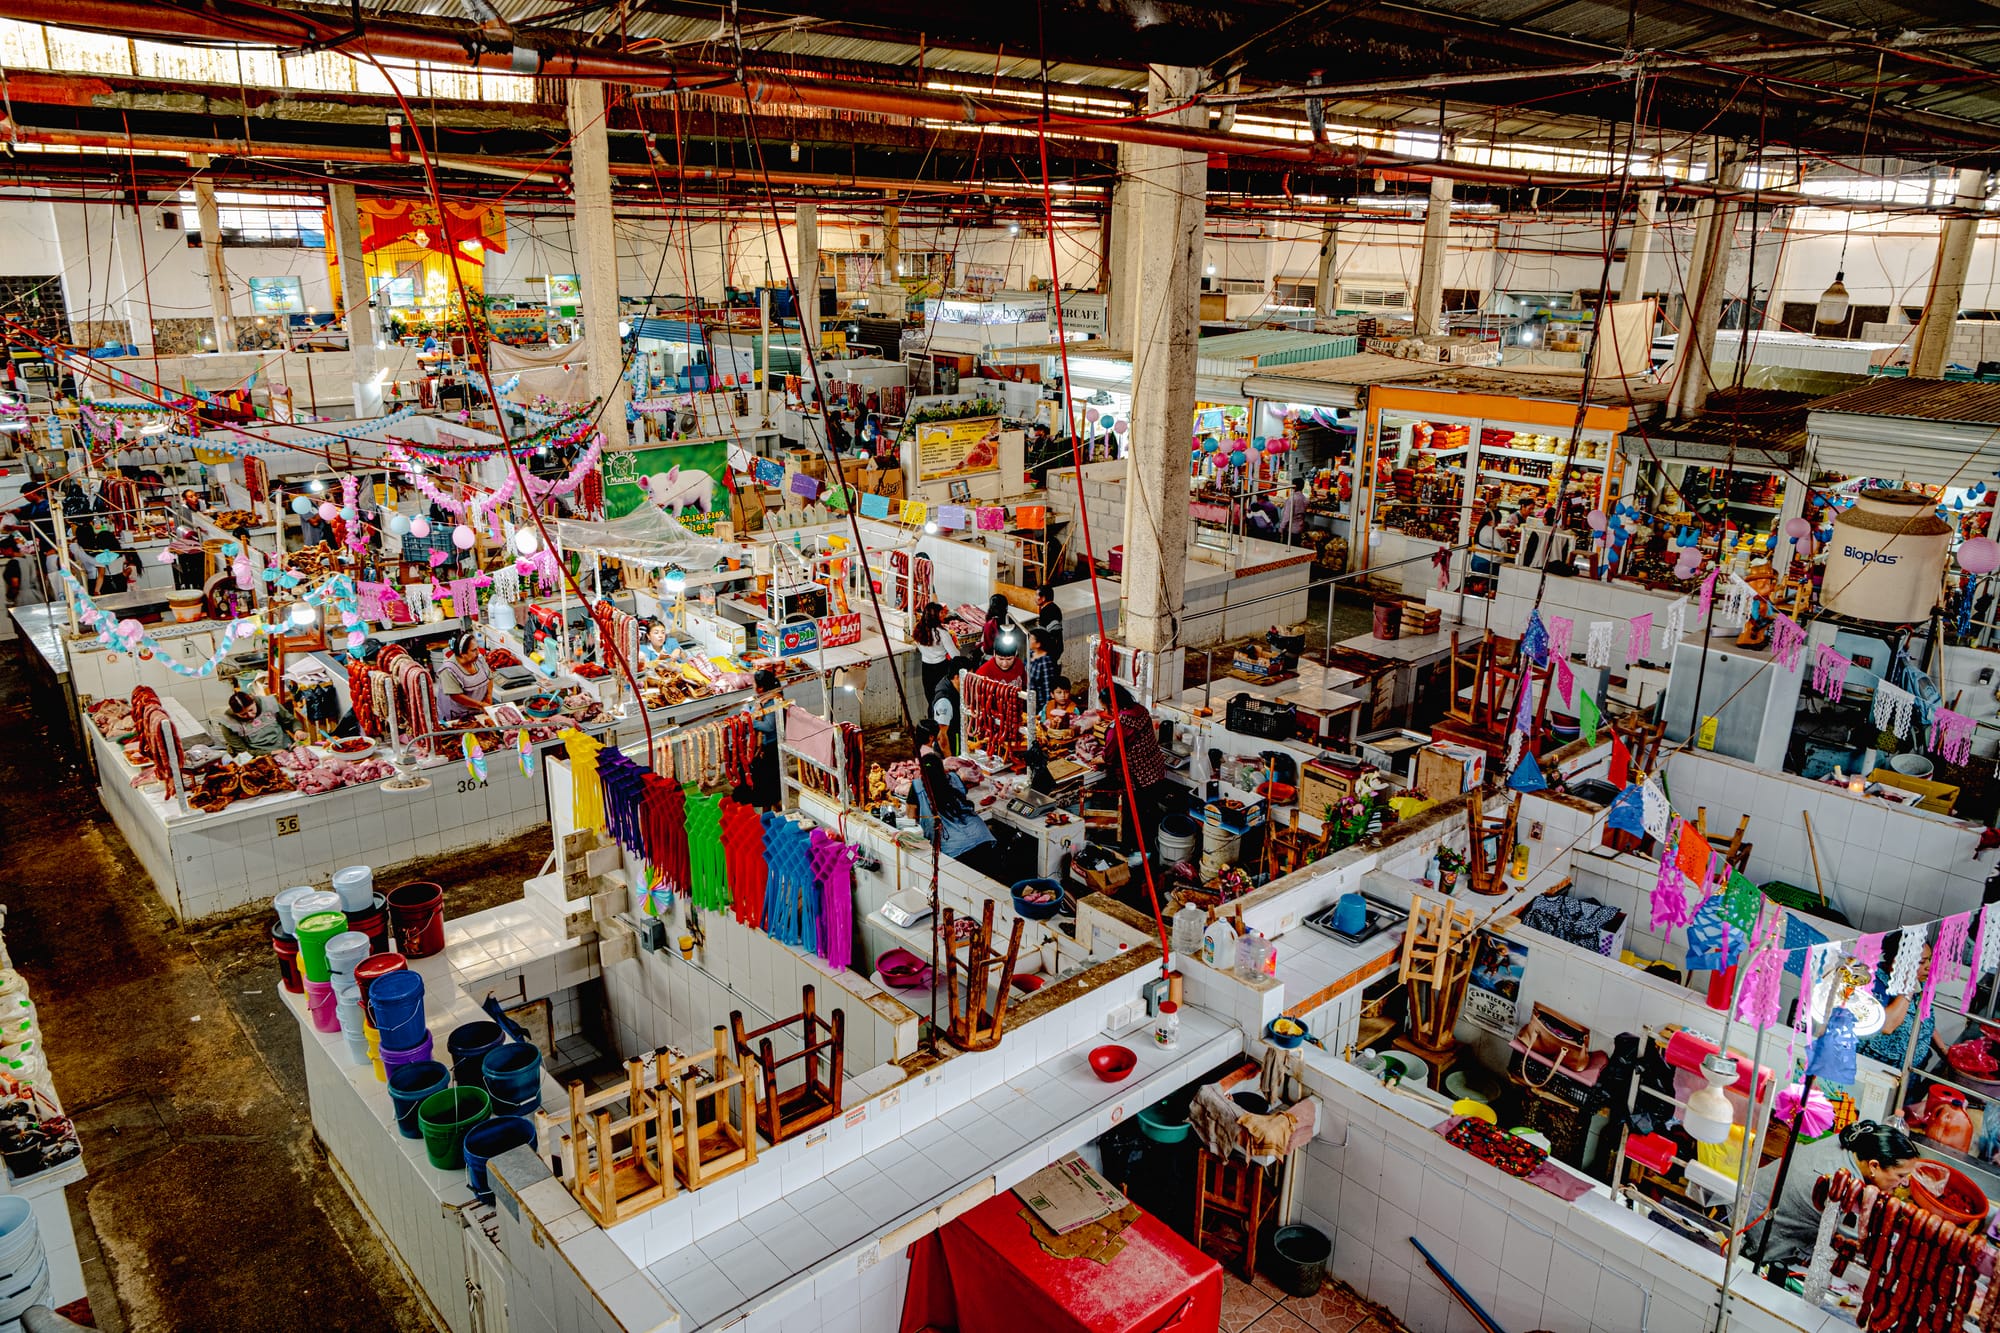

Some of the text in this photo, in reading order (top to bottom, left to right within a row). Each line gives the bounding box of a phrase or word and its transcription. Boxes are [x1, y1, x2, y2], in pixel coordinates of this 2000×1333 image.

[1844, 545, 1898, 565] Bioplas
[457, 780, 476, 793] 36
[278, 818, 297, 832] 36
[1476, 1004, 1506, 1022] LUPITA
